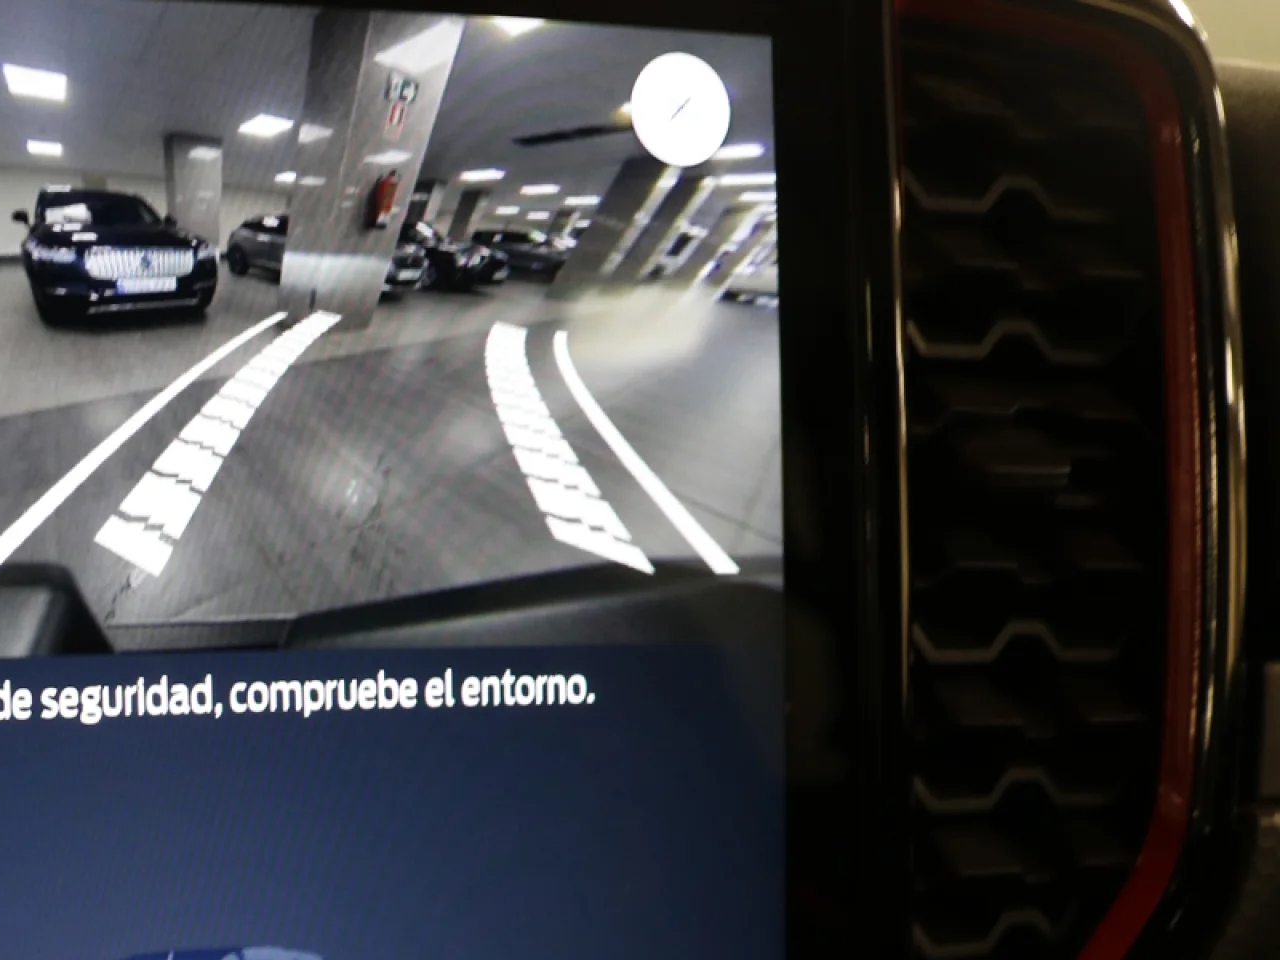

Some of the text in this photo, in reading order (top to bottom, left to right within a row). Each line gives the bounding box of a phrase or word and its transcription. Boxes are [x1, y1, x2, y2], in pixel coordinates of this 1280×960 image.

[39, 674, 224, 726] seguridad,
[229, 668, 419, 719] compruebe
[424, 668, 456, 708] el
[460, 668, 596, 708] entorno.
